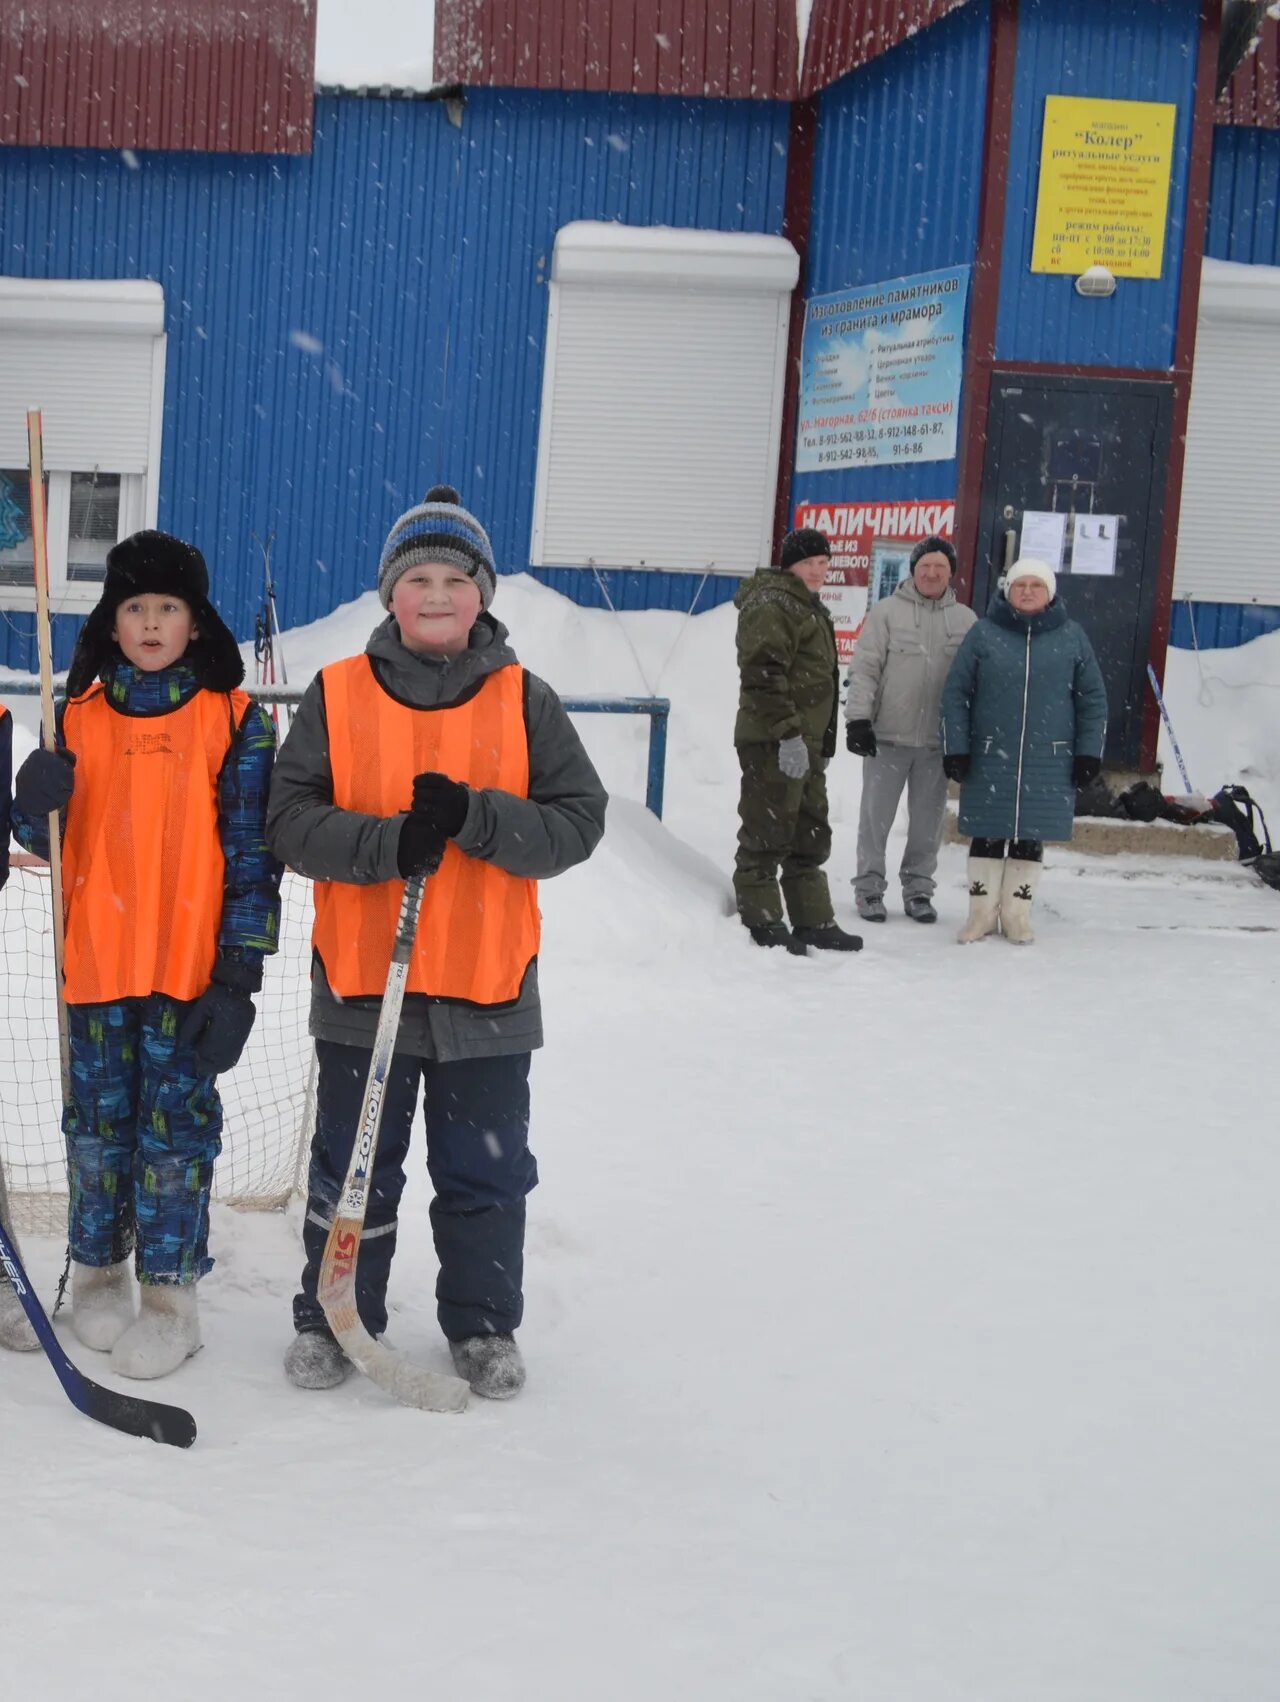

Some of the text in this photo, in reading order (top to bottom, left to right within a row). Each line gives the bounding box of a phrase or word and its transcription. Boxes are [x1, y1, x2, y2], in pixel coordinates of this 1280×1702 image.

[1052, 149, 1160, 164] ритуальные услуги
[1065, 221, 1100, 231] режим
[811, 277, 959, 320] Изготовление памятников
[821, 301, 942, 337] из гранита и мрамора
[878, 406, 919, 423] (стоянка
[921, 400, 954, 416] такси)
[892, 442, 923, 456] 91-6-86
[803, 505, 956, 536] НАЛИЧНИКИ
[845, 539, 858, 553] ИЗ
[356, 1078, 383, 1173] MOROZ
